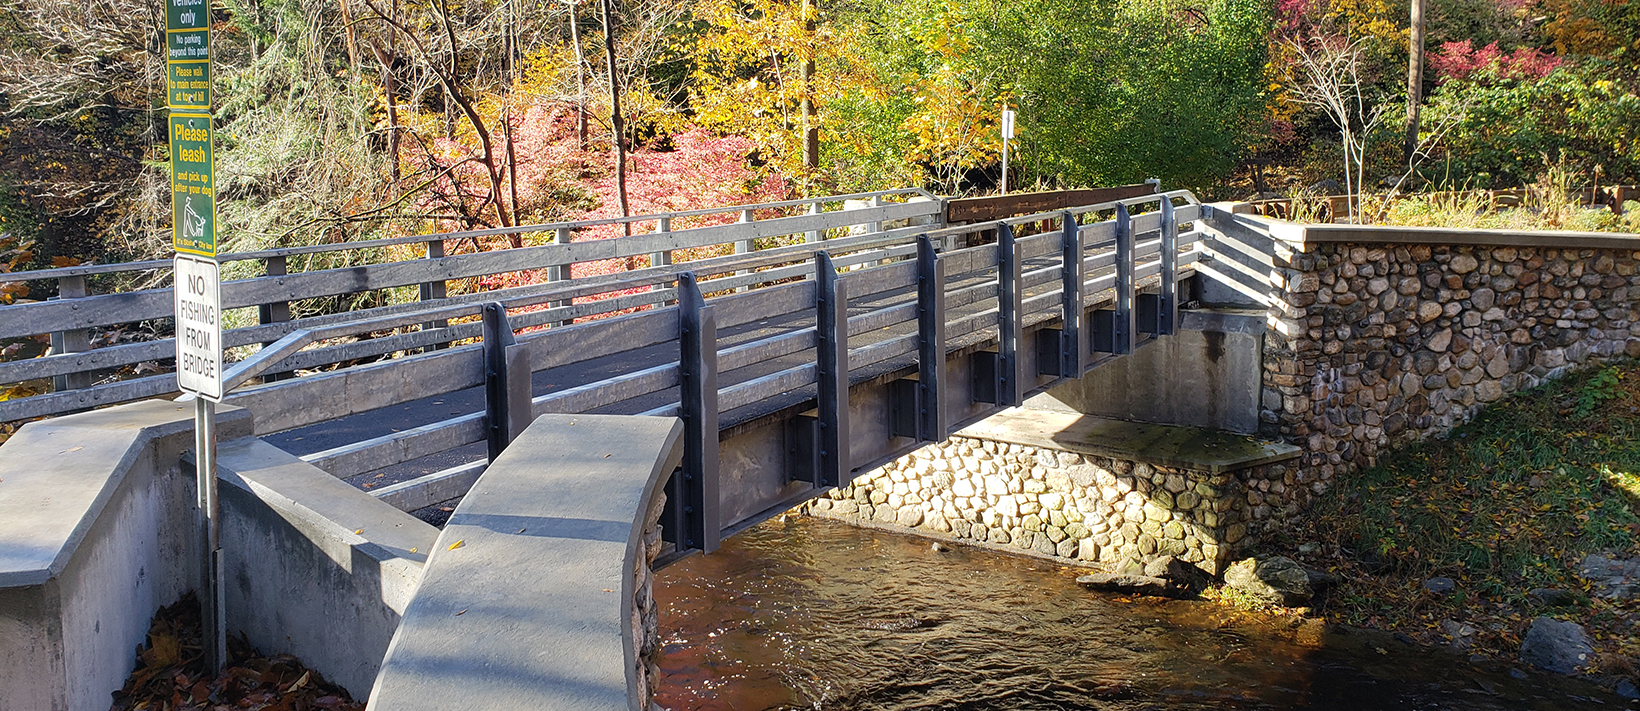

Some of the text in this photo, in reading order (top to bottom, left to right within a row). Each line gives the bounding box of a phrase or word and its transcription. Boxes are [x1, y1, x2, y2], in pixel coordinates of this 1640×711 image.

[180, 9, 196, 26] only
[176, 34, 201, 45] No parking
[168, 46, 208, 57] beyond this point
[176, 66, 203, 76] Please walk
[170, 79, 208, 89] to main entrance
[176, 91, 182, 102] at
[175, 124, 208, 142] Please
[179, 145, 206, 163] leash
[178, 171, 208, 184] and pick up
[175, 183, 212, 198] after your dog
[188, 274, 205, 296] NO
[180, 300, 214, 325] FISHING
[186, 327, 210, 351] FROM
[184, 352, 214, 379] BRIDGE
